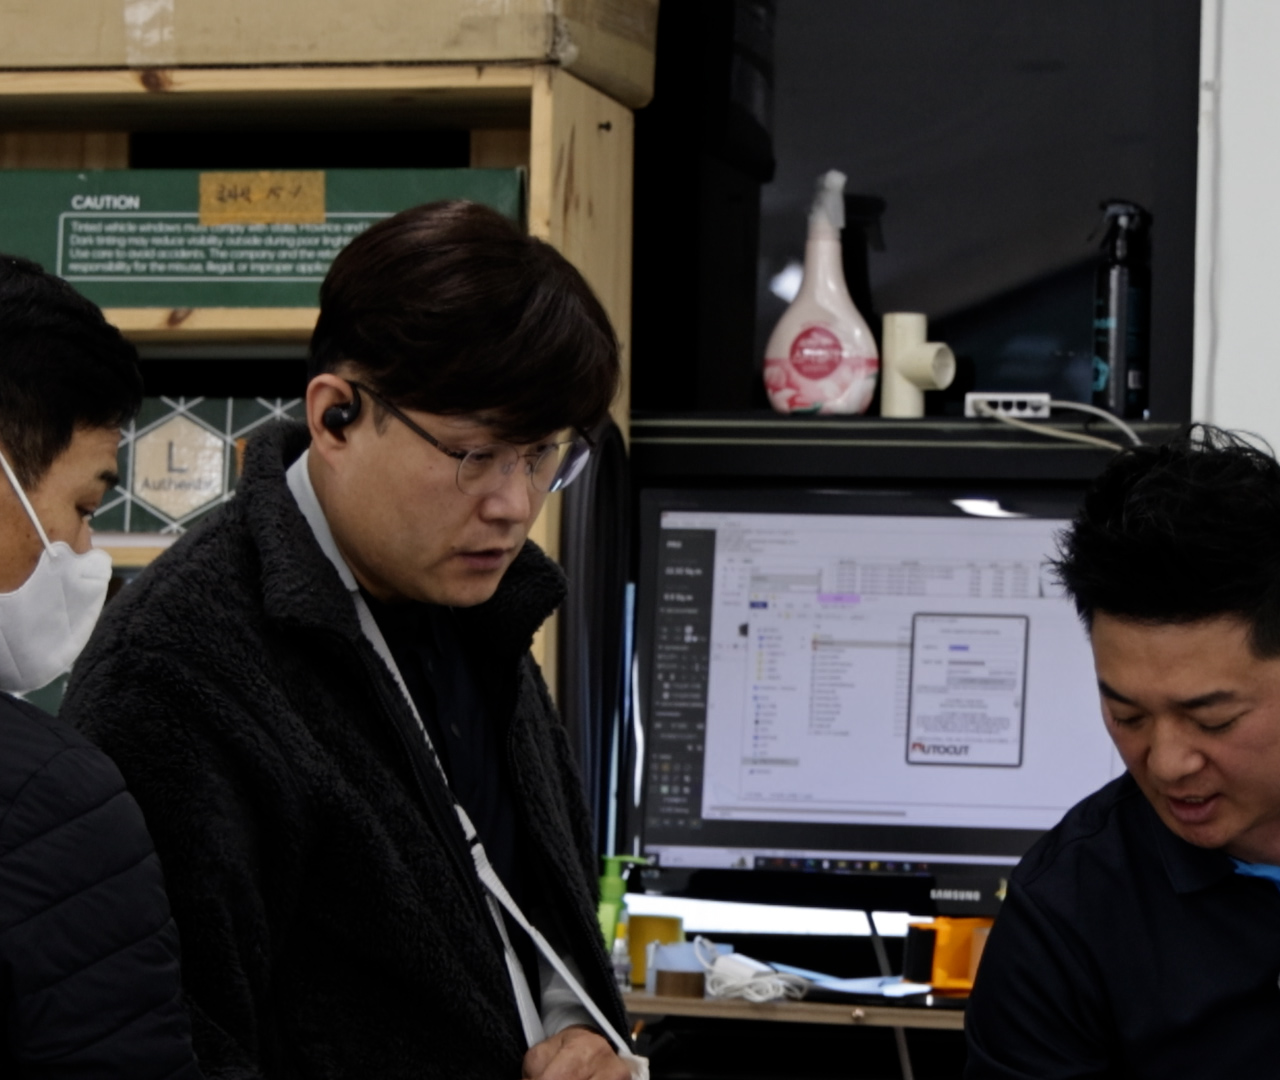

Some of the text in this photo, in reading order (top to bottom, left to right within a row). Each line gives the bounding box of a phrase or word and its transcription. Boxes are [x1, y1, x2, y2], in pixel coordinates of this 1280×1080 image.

[71, 194, 140, 210] CAUTION
[71, 221, 102, 233] Tinted
[104, 221, 136, 233] vehicle
[138, 221, 181, 233] windows
[70, 234, 93, 246] Dark
[128, 237, 148, 248] may
[150, 235, 185, 247] reduce
[225, 235, 262, 247] outside
[265, 235, 295, 249] during
[296, 237, 320, 249] poor
[69, 248, 90, 259] Use
[209, 249, 228, 260] The
[277, 250, 297, 260] and
[133, 261, 147, 272] for
[149, 262, 166, 272] the
[168, 441, 187, 473] L
[930, 888, 981, 902] SAMSUNG
